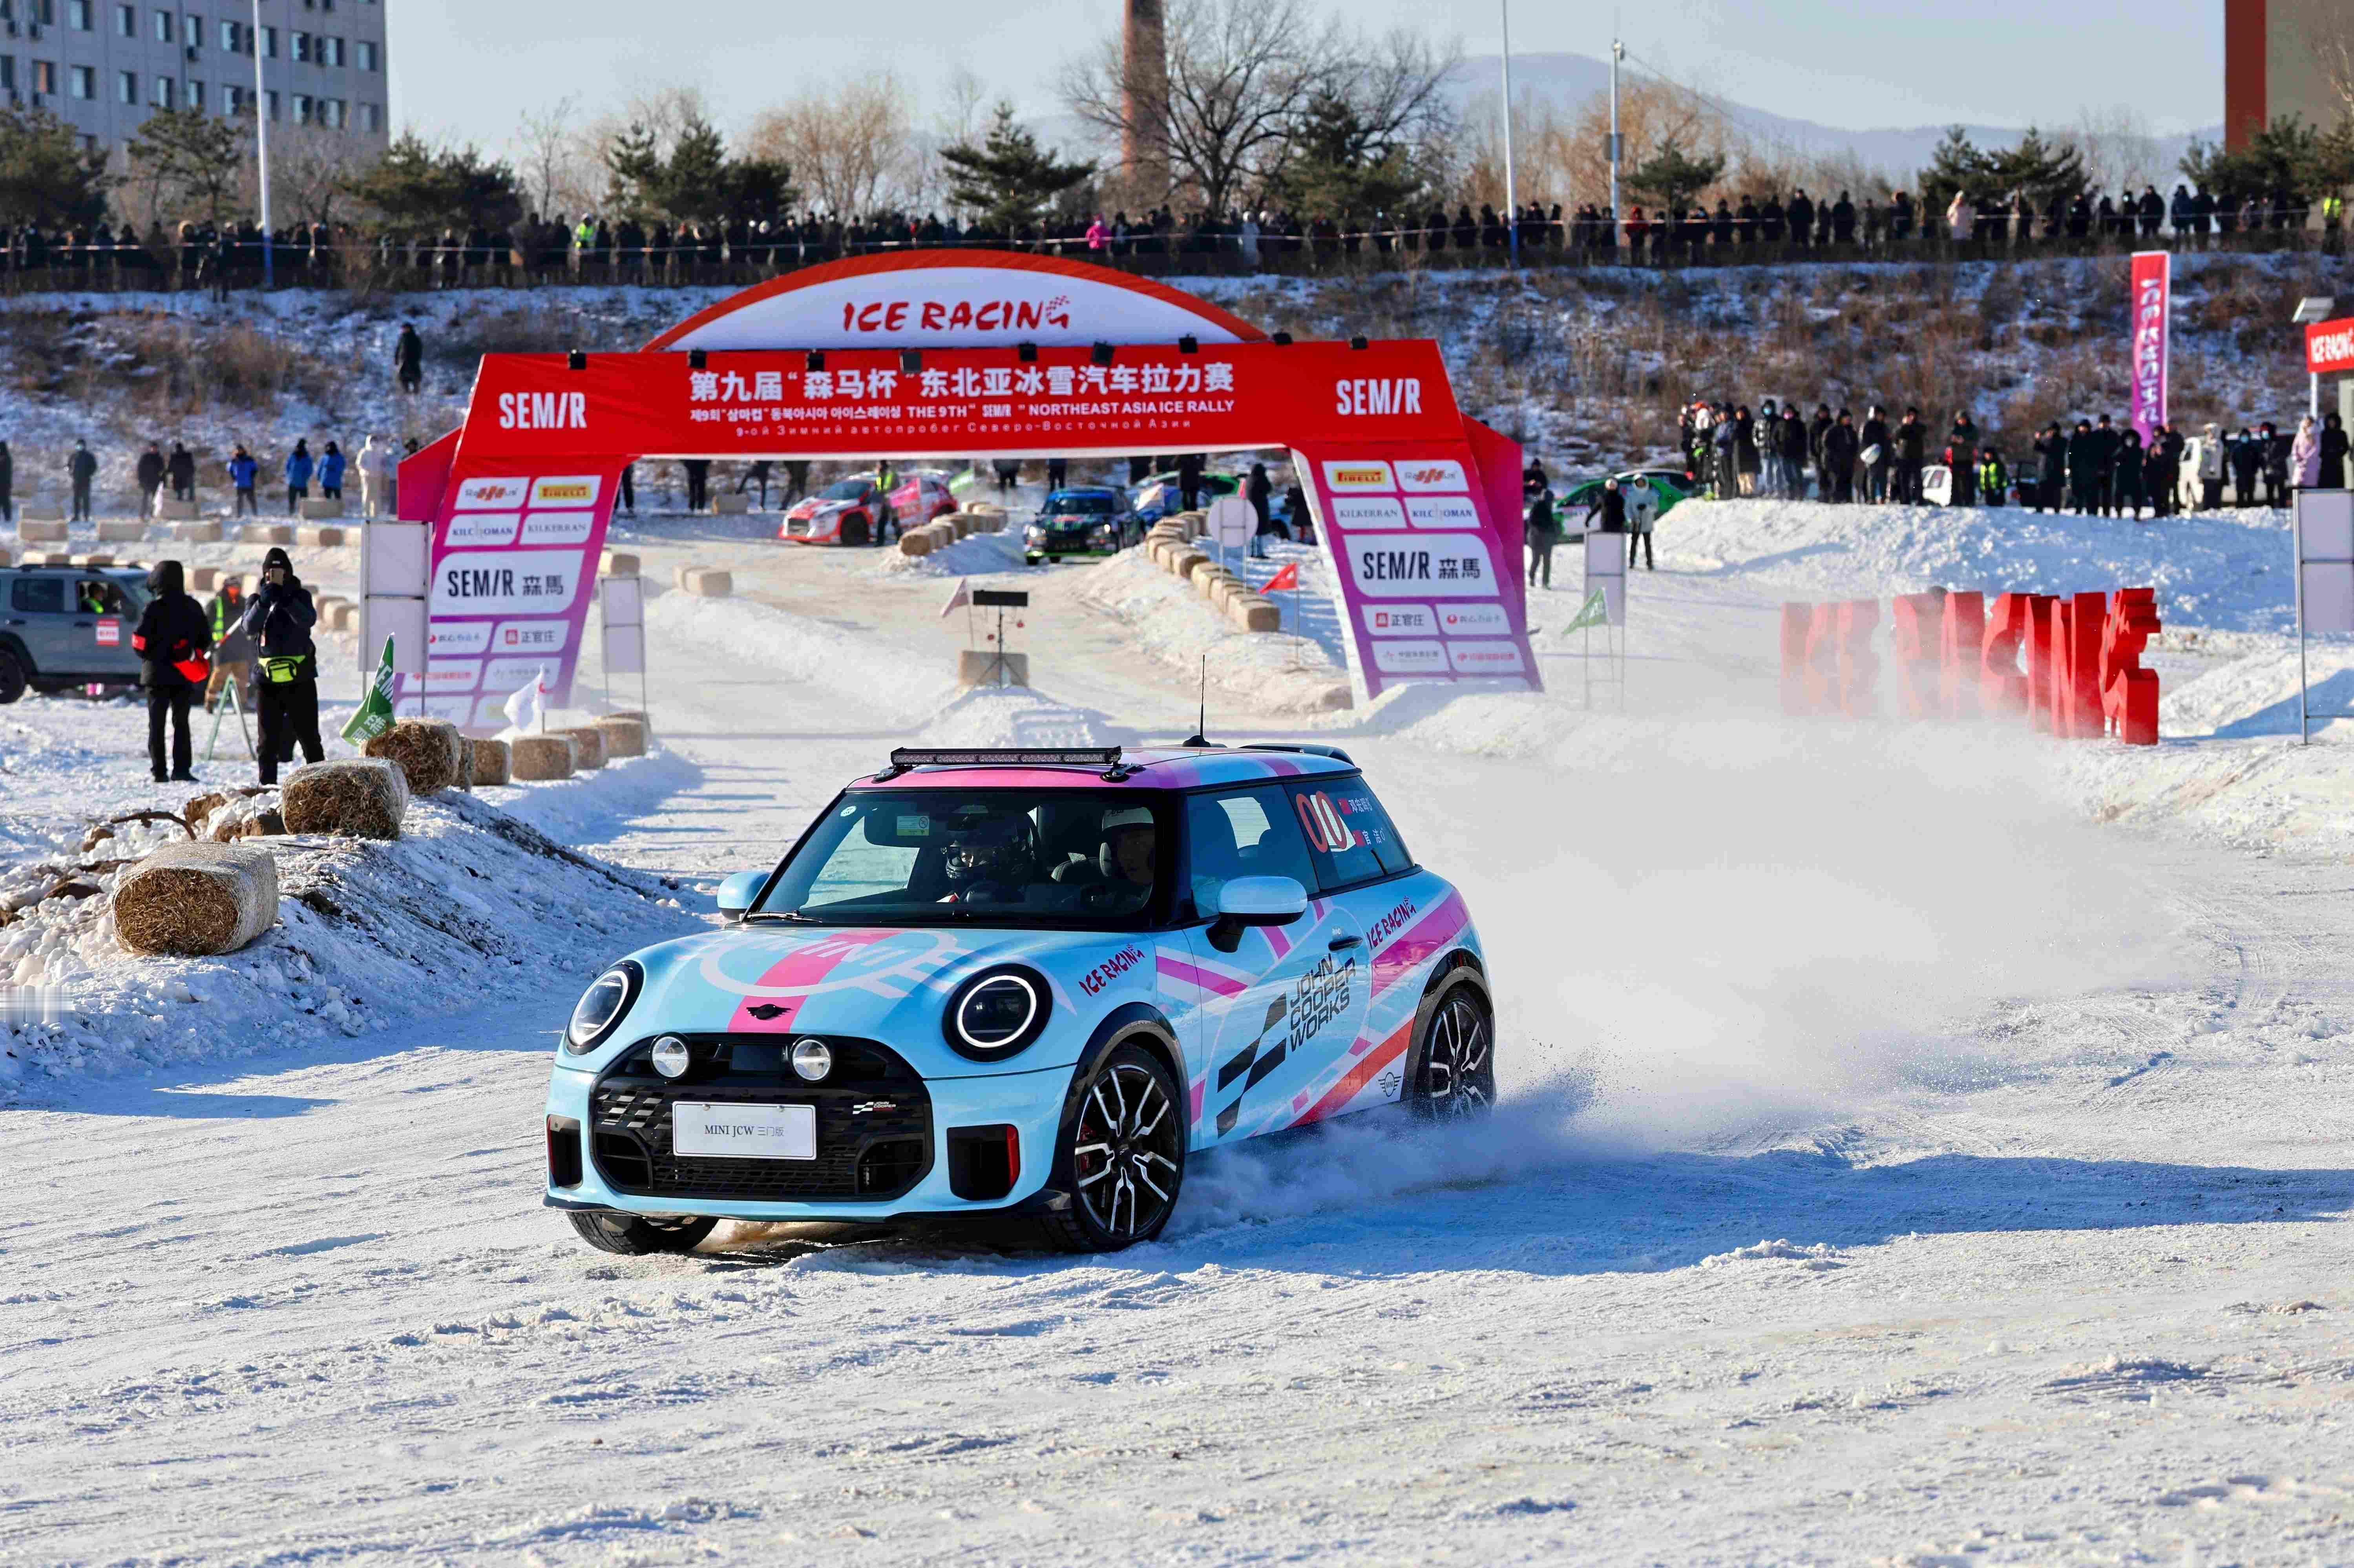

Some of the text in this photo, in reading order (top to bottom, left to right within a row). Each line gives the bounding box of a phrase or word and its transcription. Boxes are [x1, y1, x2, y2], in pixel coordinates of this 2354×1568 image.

[844, 295, 1070, 332] ICE RACING
[907, 405, 937, 418] THE
[1121, 402, 1157, 414] ASIA
[1159, 401, 1184, 413] ICE
[1187, 400, 1235, 413] RALLY
[1296, 790, 1347, 853] 00
[1366, 895, 1417, 950] ICE RACING
[1078, 943, 1145, 997] ICE RACING
[1290, 953, 1334, 1008] JOHN
[1290, 956, 1356, 1031] COOPER
[1290, 986, 1350, 1052] WORKS
[705, 1124, 784, 1137] MINI JCW 三门版
